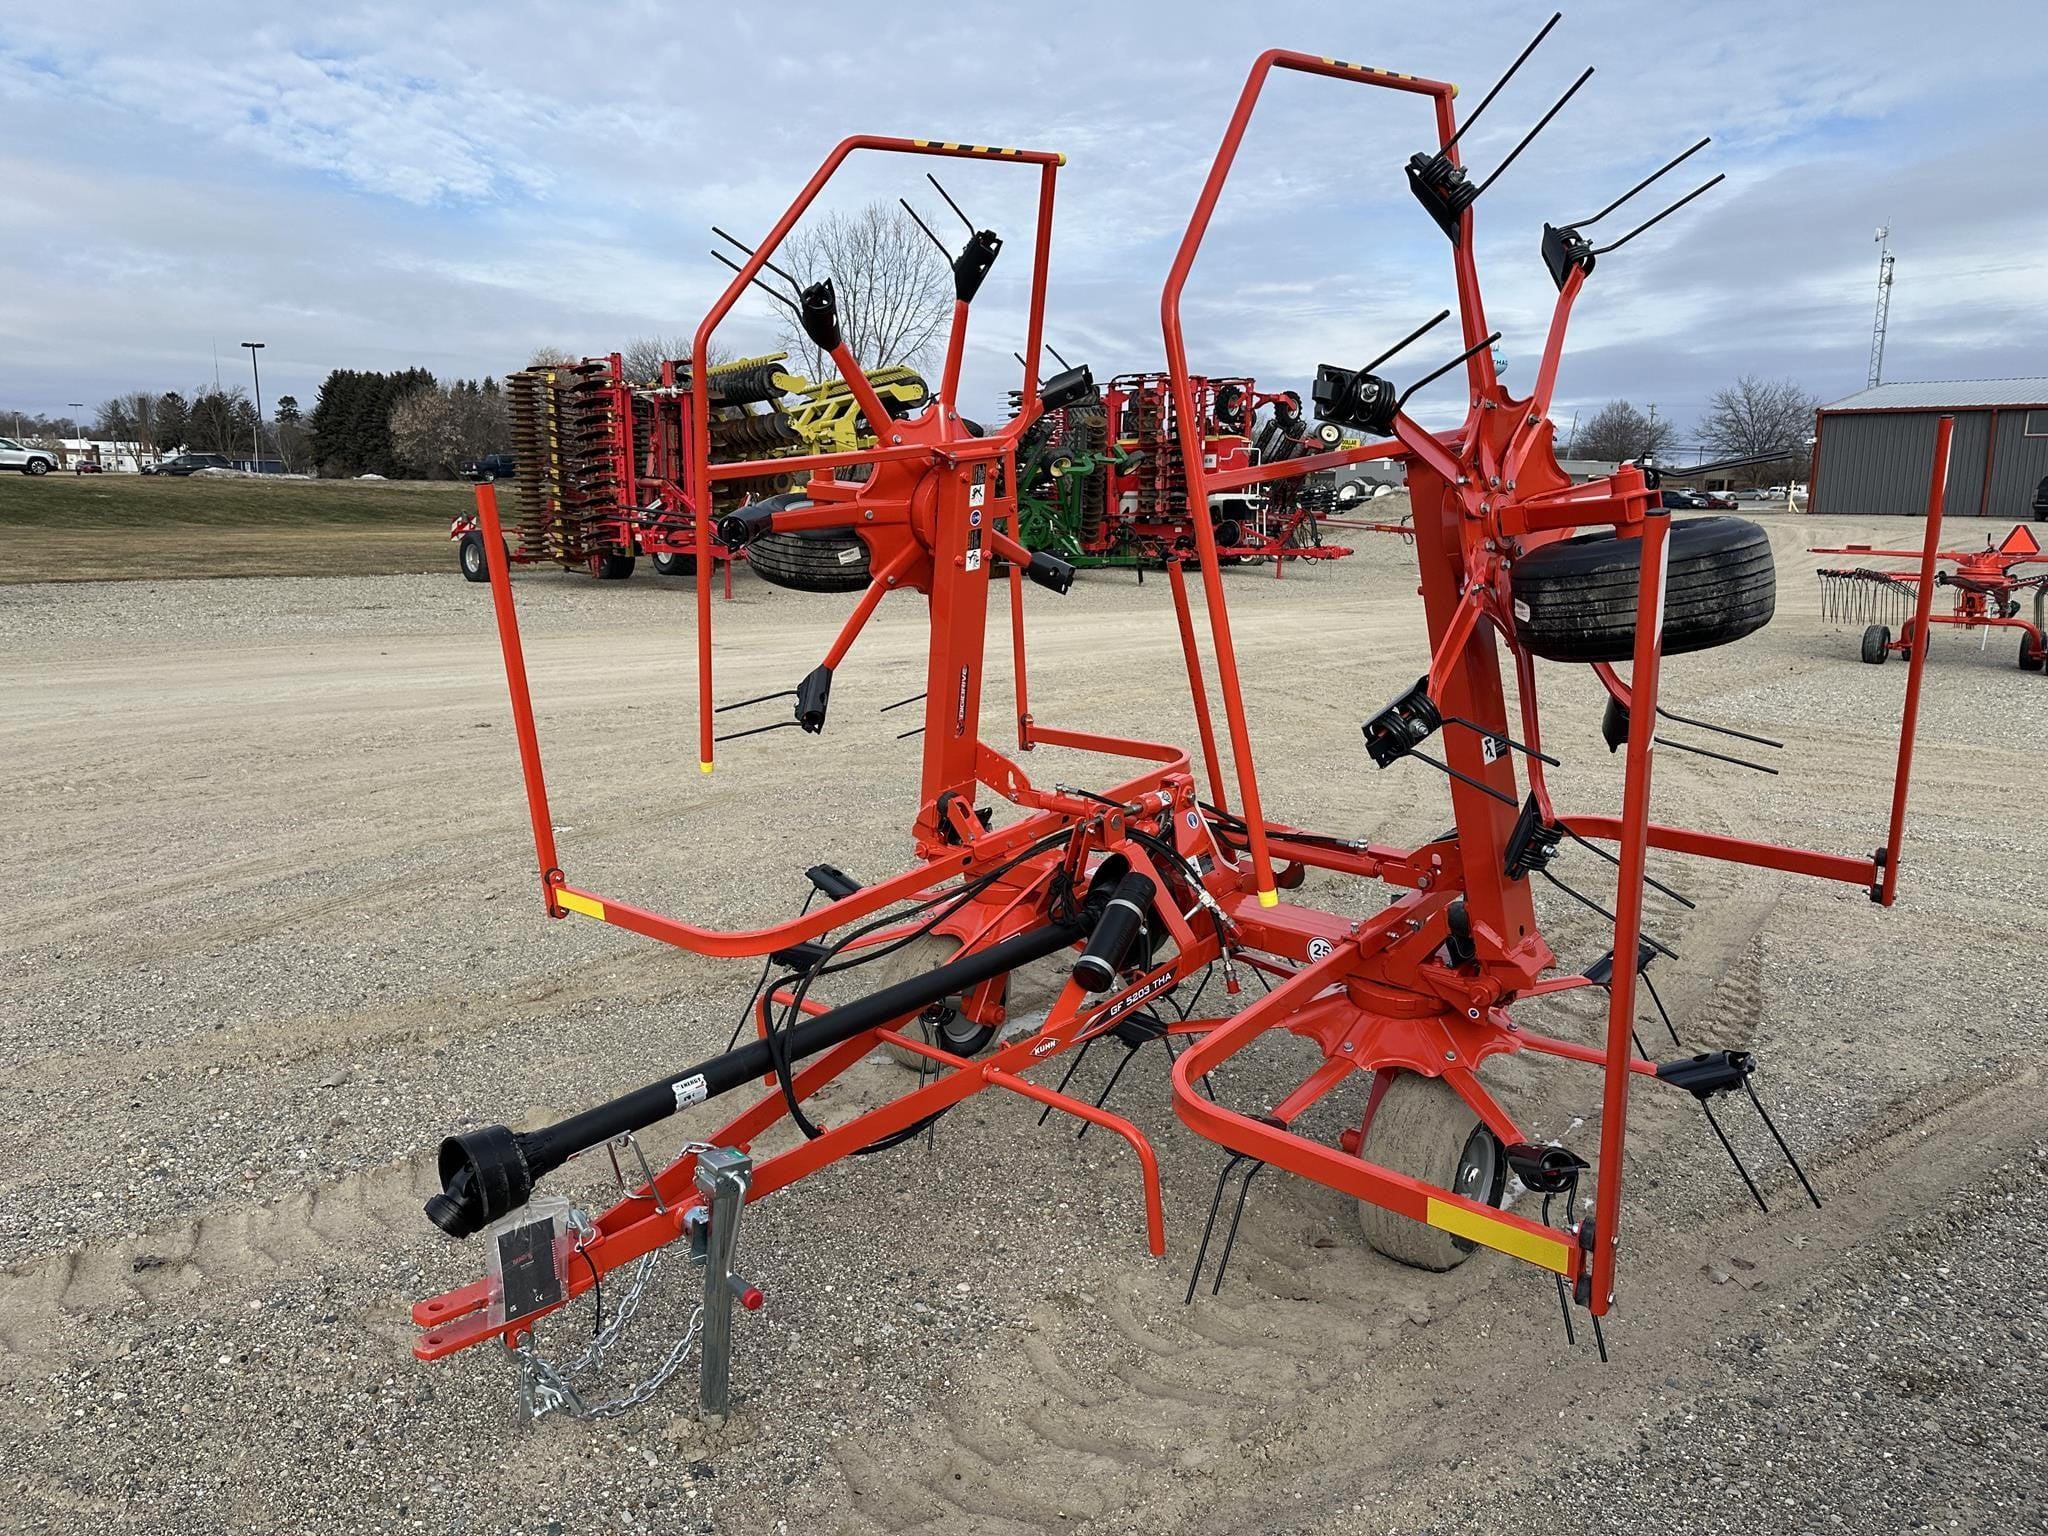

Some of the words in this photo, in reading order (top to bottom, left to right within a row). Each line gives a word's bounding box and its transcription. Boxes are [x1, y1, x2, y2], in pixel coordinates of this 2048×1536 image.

[1313, 943, 1330, 957] 25
[1110, 1002, 1124, 1017] GF
[1125, 986, 1151, 1008] 5203
[1151, 972, 1173, 990] THA
[1034, 1040, 1056, 1056] KUHN
